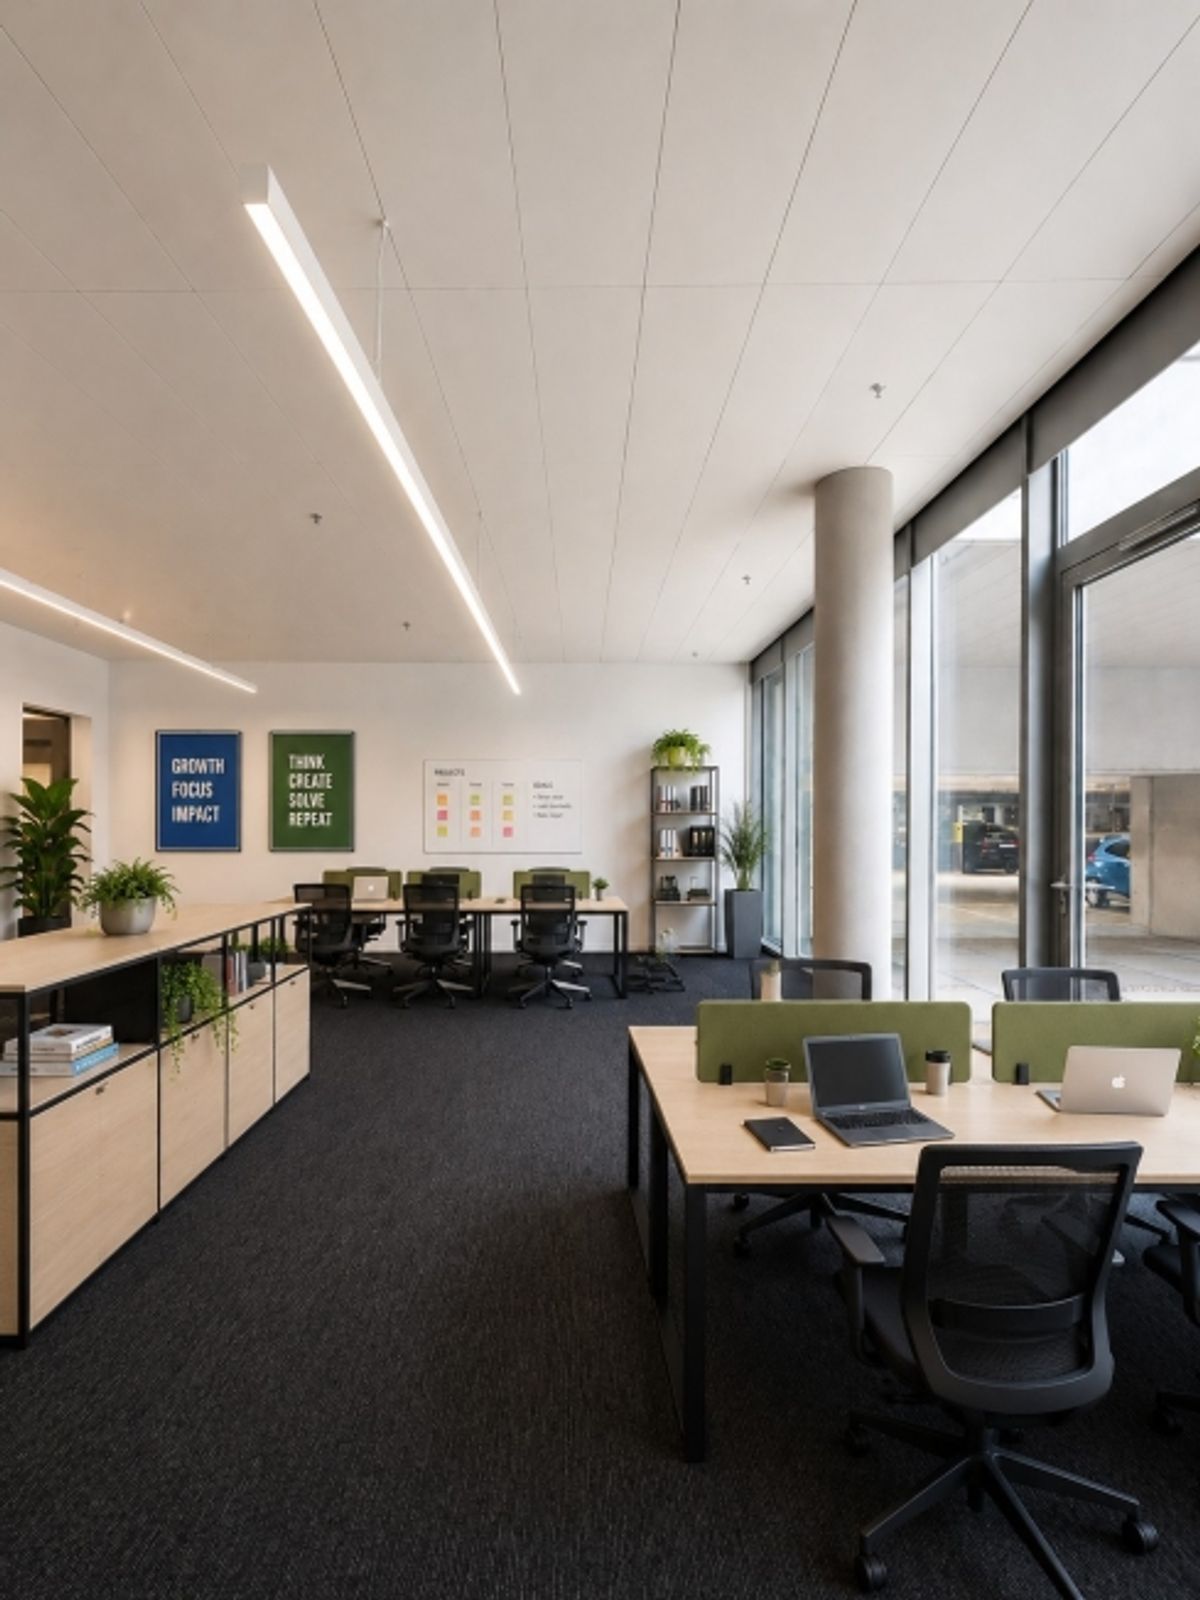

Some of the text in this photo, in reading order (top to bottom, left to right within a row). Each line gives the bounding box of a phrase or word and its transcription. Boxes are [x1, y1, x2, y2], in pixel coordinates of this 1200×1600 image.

[171, 758, 225, 774] GROWTH
[289, 754, 325, 769] THINK
[289, 773, 333, 789] CREATE
[171, 781, 213, 799] FOCUS
[289, 793, 325, 808] SOLVE
[171, 805, 220, 823] IMPACT
[289, 812, 333, 827] REPEAT
